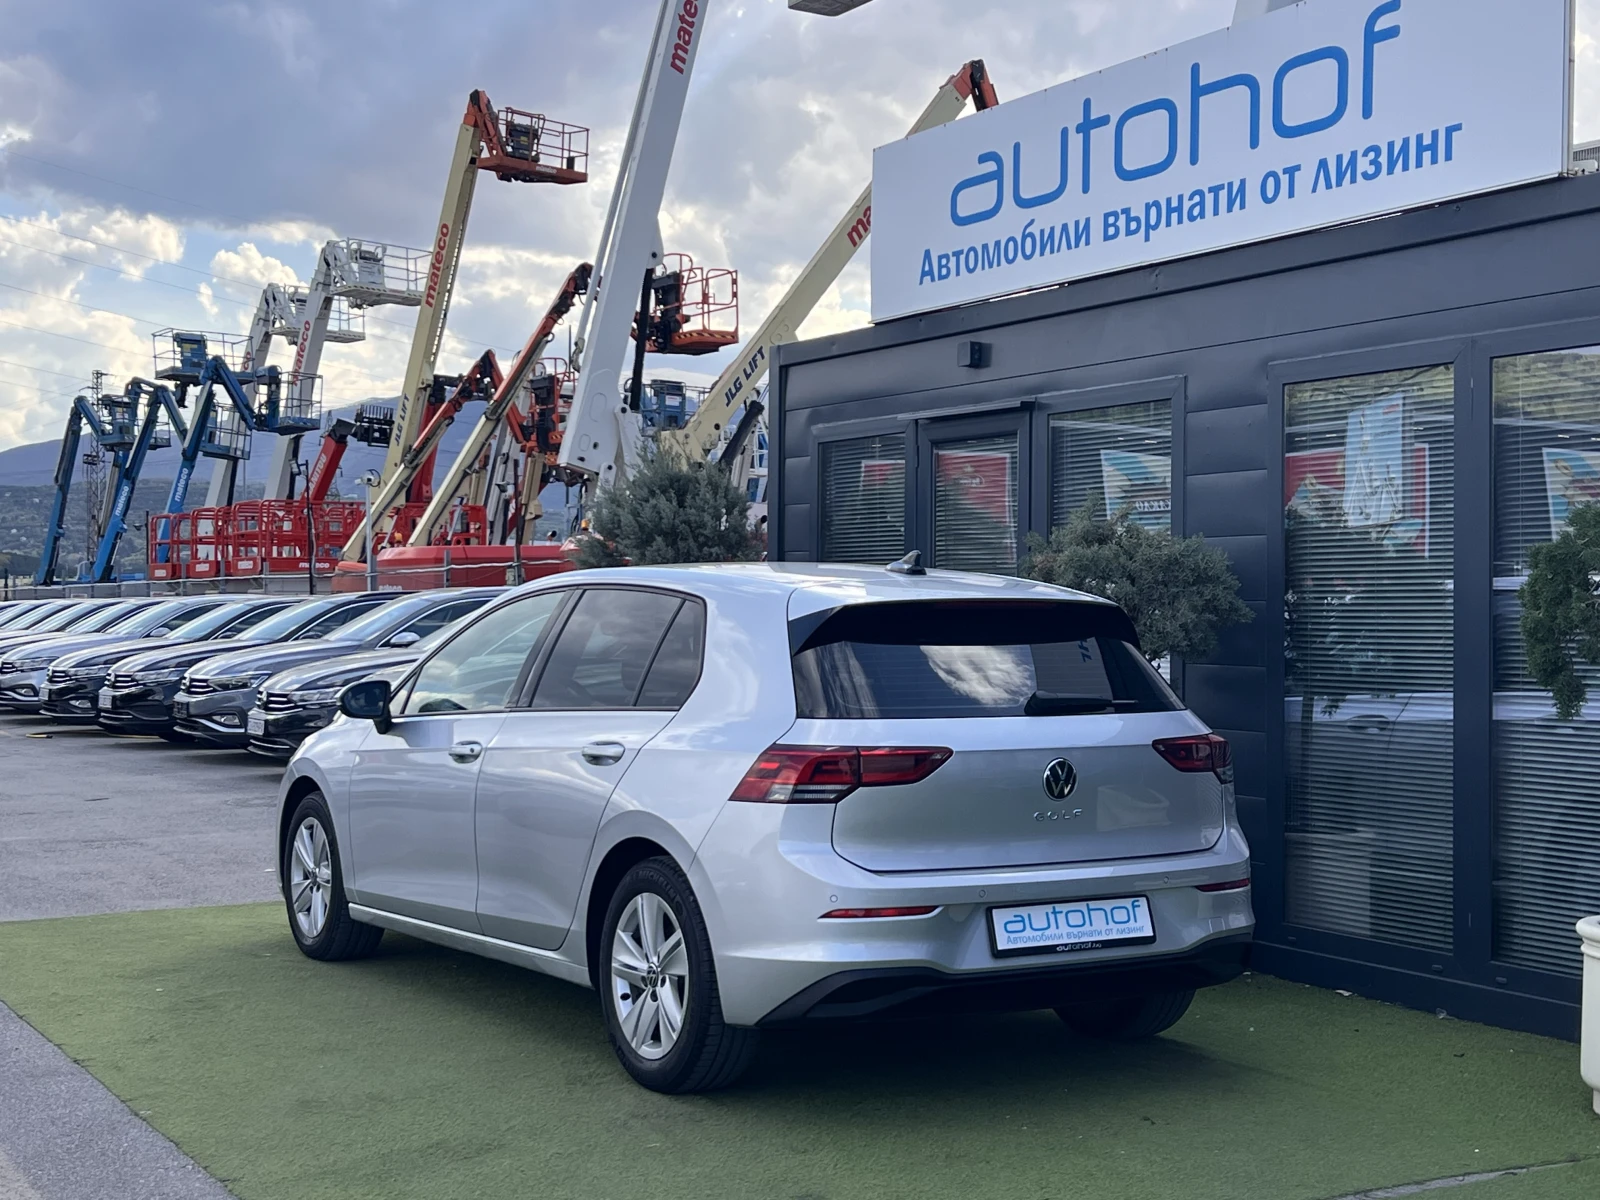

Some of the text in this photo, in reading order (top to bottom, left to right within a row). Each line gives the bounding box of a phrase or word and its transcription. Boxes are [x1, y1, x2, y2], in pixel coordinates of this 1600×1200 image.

[671, 0, 699, 75] mate
[950, 0, 1402, 226] autohof
[920, 122, 1463, 285] Автомобили върнати от лизинг
[425, 223, 449, 308] mateco
[724, 345, 765, 407] JLG LIFT
[400, 393, 409, 421] LIFT
[114, 485, 130, 517] mateco
[174, 467, 189, 502] mateco
[1033, 807, 1082, 821] GOLF
[1003, 899, 1141, 934] autohof
[1006, 925, 1145, 945] Автомобили върнати от лизинг
